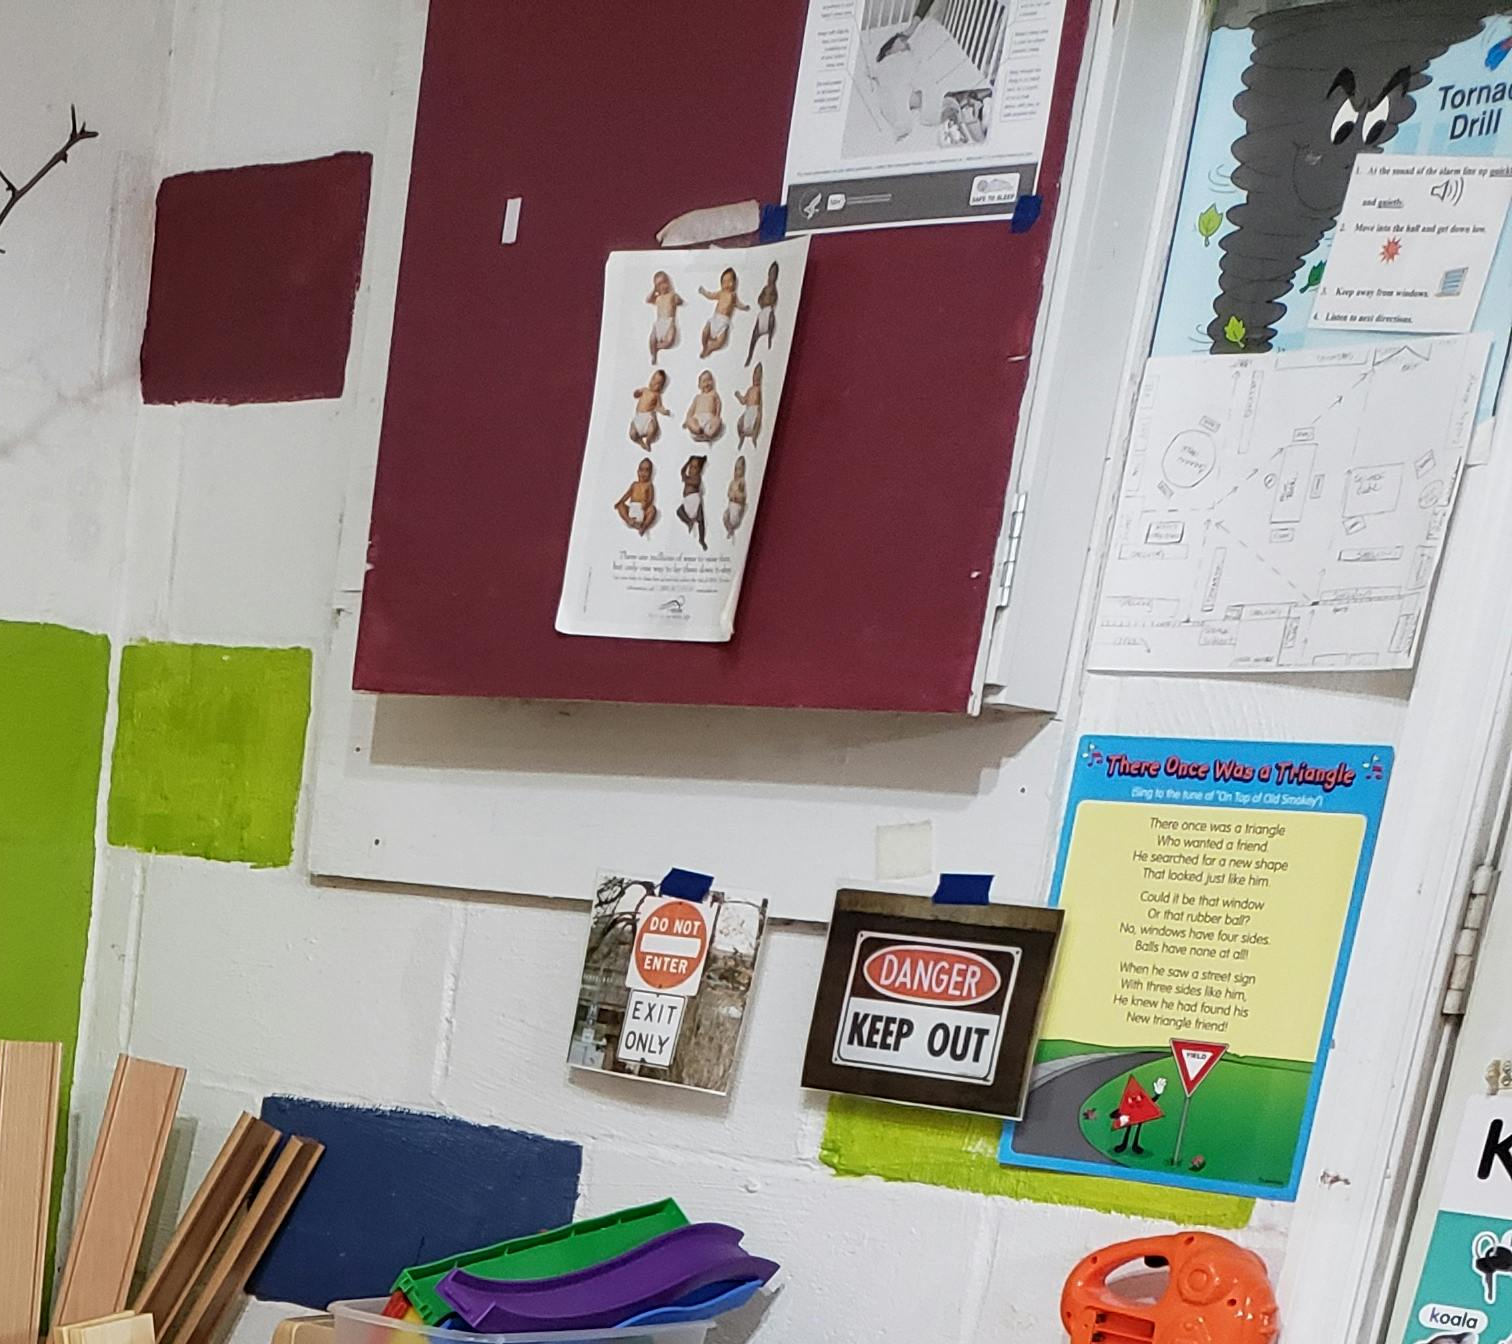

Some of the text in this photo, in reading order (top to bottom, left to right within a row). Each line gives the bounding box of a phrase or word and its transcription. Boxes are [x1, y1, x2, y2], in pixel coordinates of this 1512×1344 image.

[1449, 108, 1503, 140] Drill
[1107, 752, 1356, 792] There Once Was a Triangle
[1151, 817, 1286, 838] There once was a triangle
[1157, 835, 1181, 847] Who
[1184, 839, 1224, 849] wanted
[1226, 841, 1233, 850] a
[1133, 850, 1288, 872] He searched for a new shape
[1144, 867, 1165, 880] That
[1168, 869, 1204, 882] looked
[1204, 873, 1225, 886] just
[1228, 873, 1246, 885] like
[1140, 891, 1265, 910] Could it be that window
[649, 917, 701, 935] DO NOT
[1148, 907, 1161, 919] Or
[1164, 909, 1184, 921] that
[1186, 912, 1222, 924] rubber
[1140, 925, 1186, 938] windows
[1188, 928, 1214, 940] have
[1218, 929, 1239, 942] four
[1135, 940, 1159, 952] Balls
[1161, 942, 1187, 955] have
[1189, 947, 1216, 958] none
[1219, 948, 1230, 958] at
[643, 955, 688, 974] ENTER
[1120, 961, 1256, 987] When he saw a street sign
[879, 954, 981, 997] DANGER
[1121, 977, 1143, 990] With
[1146, 981, 1173, 993] three
[1174, 984, 1202, 996] sides
[1204, 985, 1222, 998] like
[632, 1001, 677, 1024] EXIT
[1113, 994, 1249, 1017] He knew he had found his
[1127, 1011, 1150, 1024] New
[1153, 1014, 1192, 1030] triangle
[625, 1031, 670, 1055] ONLY
[847, 1012, 990, 1063] KEEP OUT
[1429, 1308, 1478, 1328] koala
